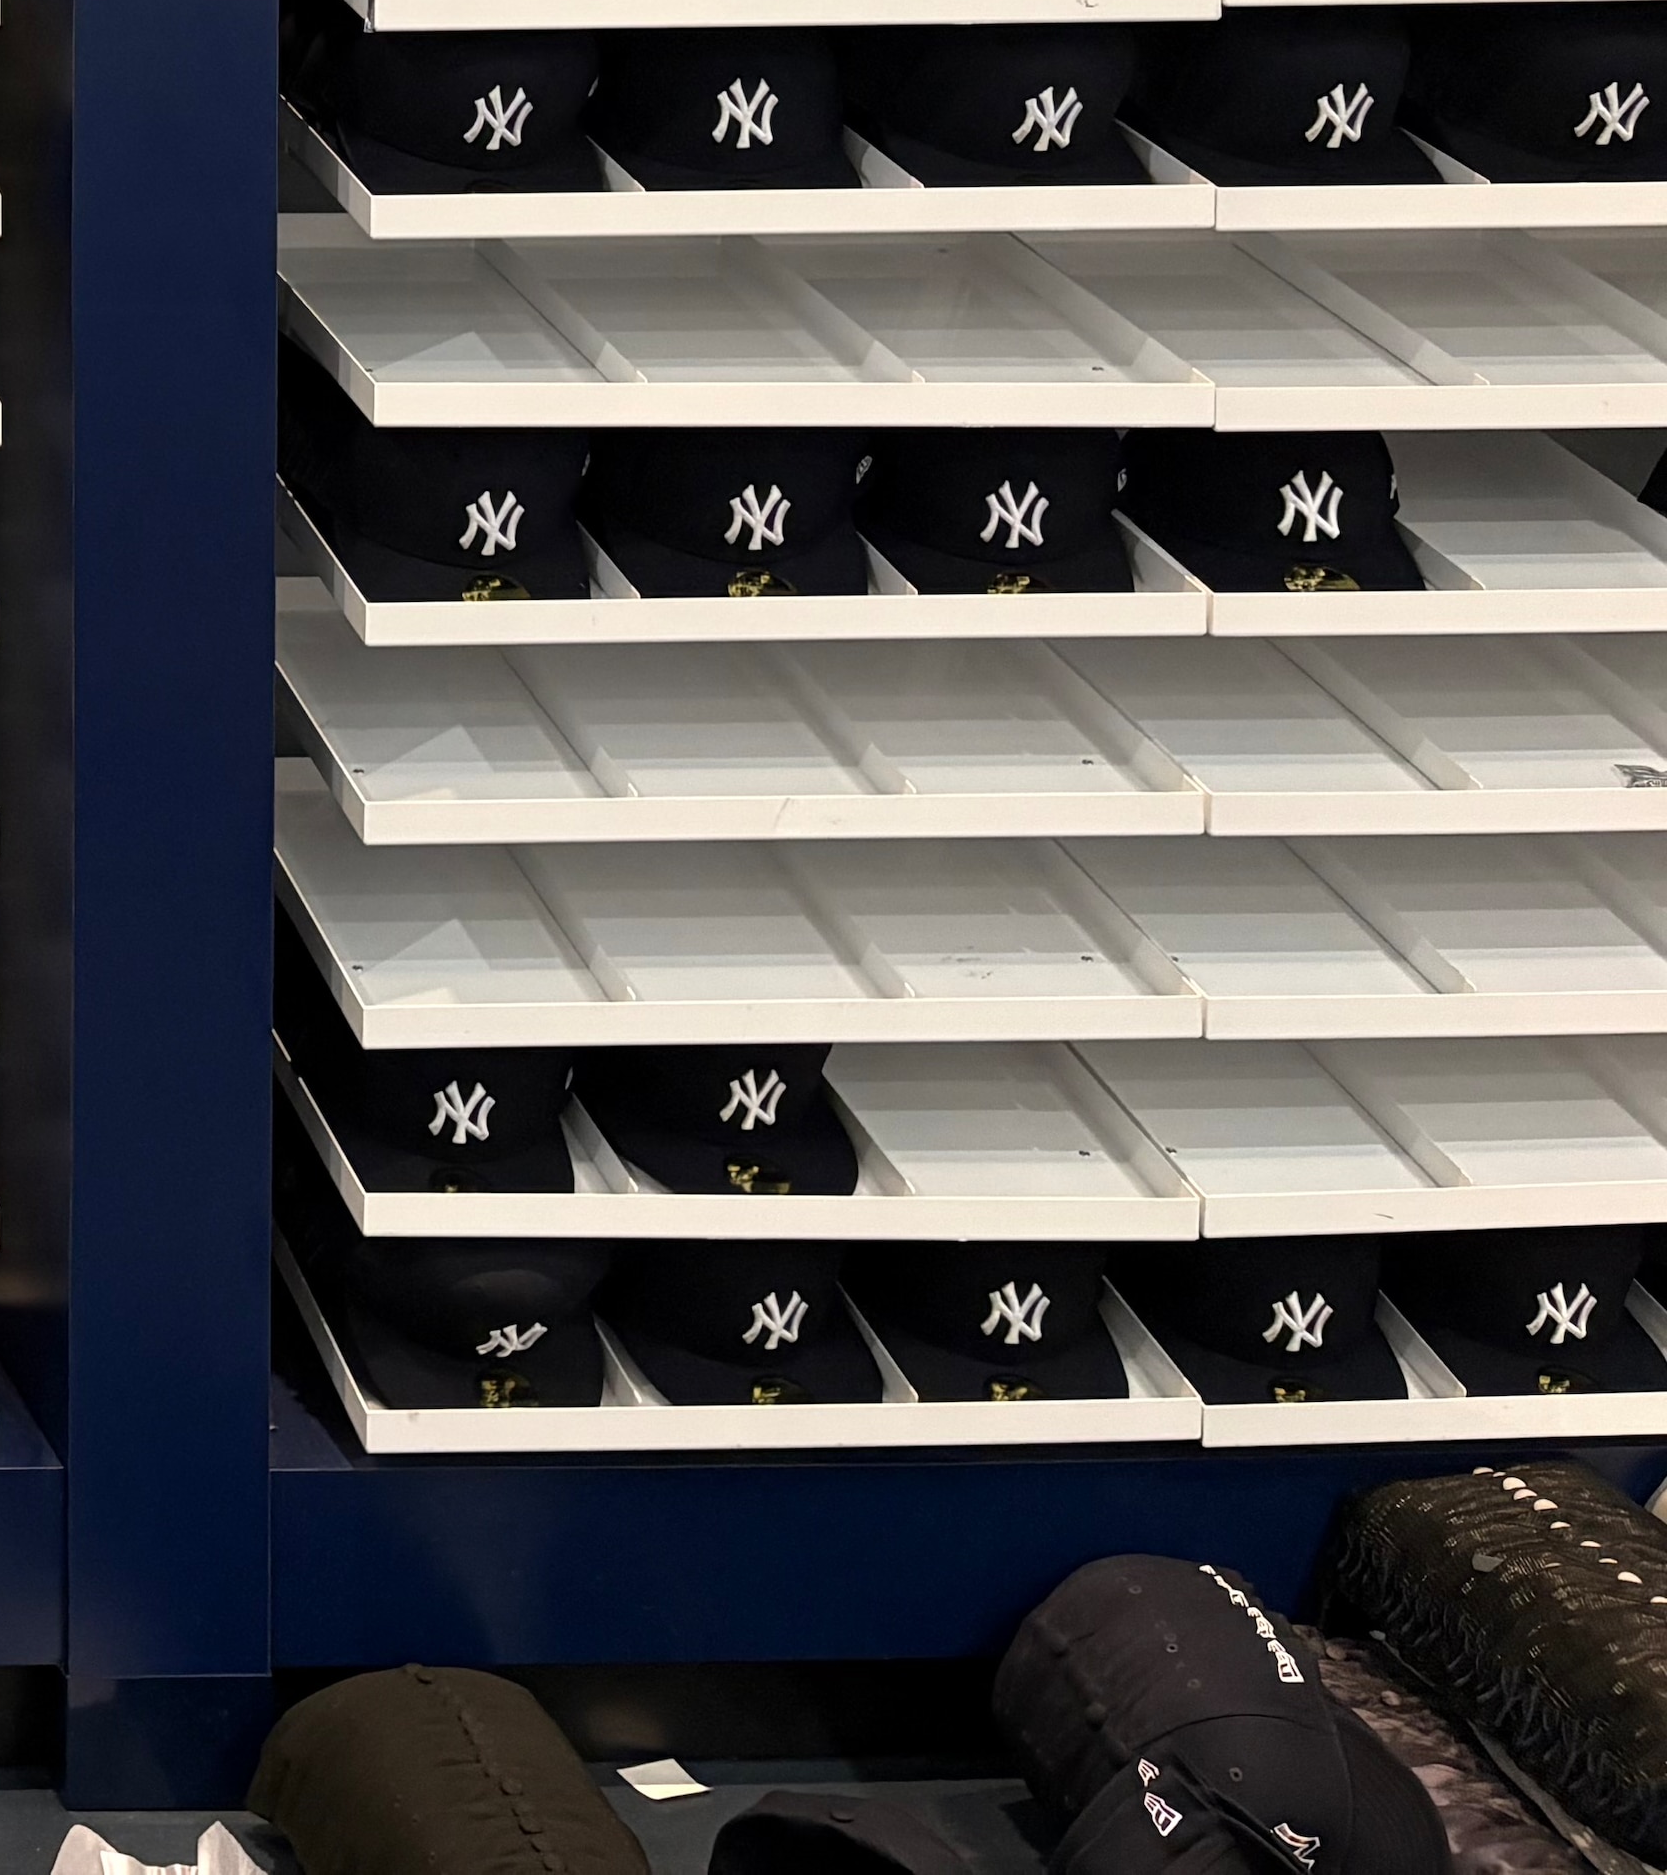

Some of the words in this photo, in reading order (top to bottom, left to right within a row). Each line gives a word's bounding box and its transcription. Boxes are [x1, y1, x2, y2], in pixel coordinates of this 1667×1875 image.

[463, 84, 533, 151] NY
[711, 77, 779, 150] NY
[1304, 82, 1375, 149] NY
[724, 484, 791, 551] NY
[1277, 470, 1344, 542] NY
[427, 1080, 496, 1144] NY
[980, 1280, 1051, 1345] NY
[1526, 1281, 1597, 1345] NY
